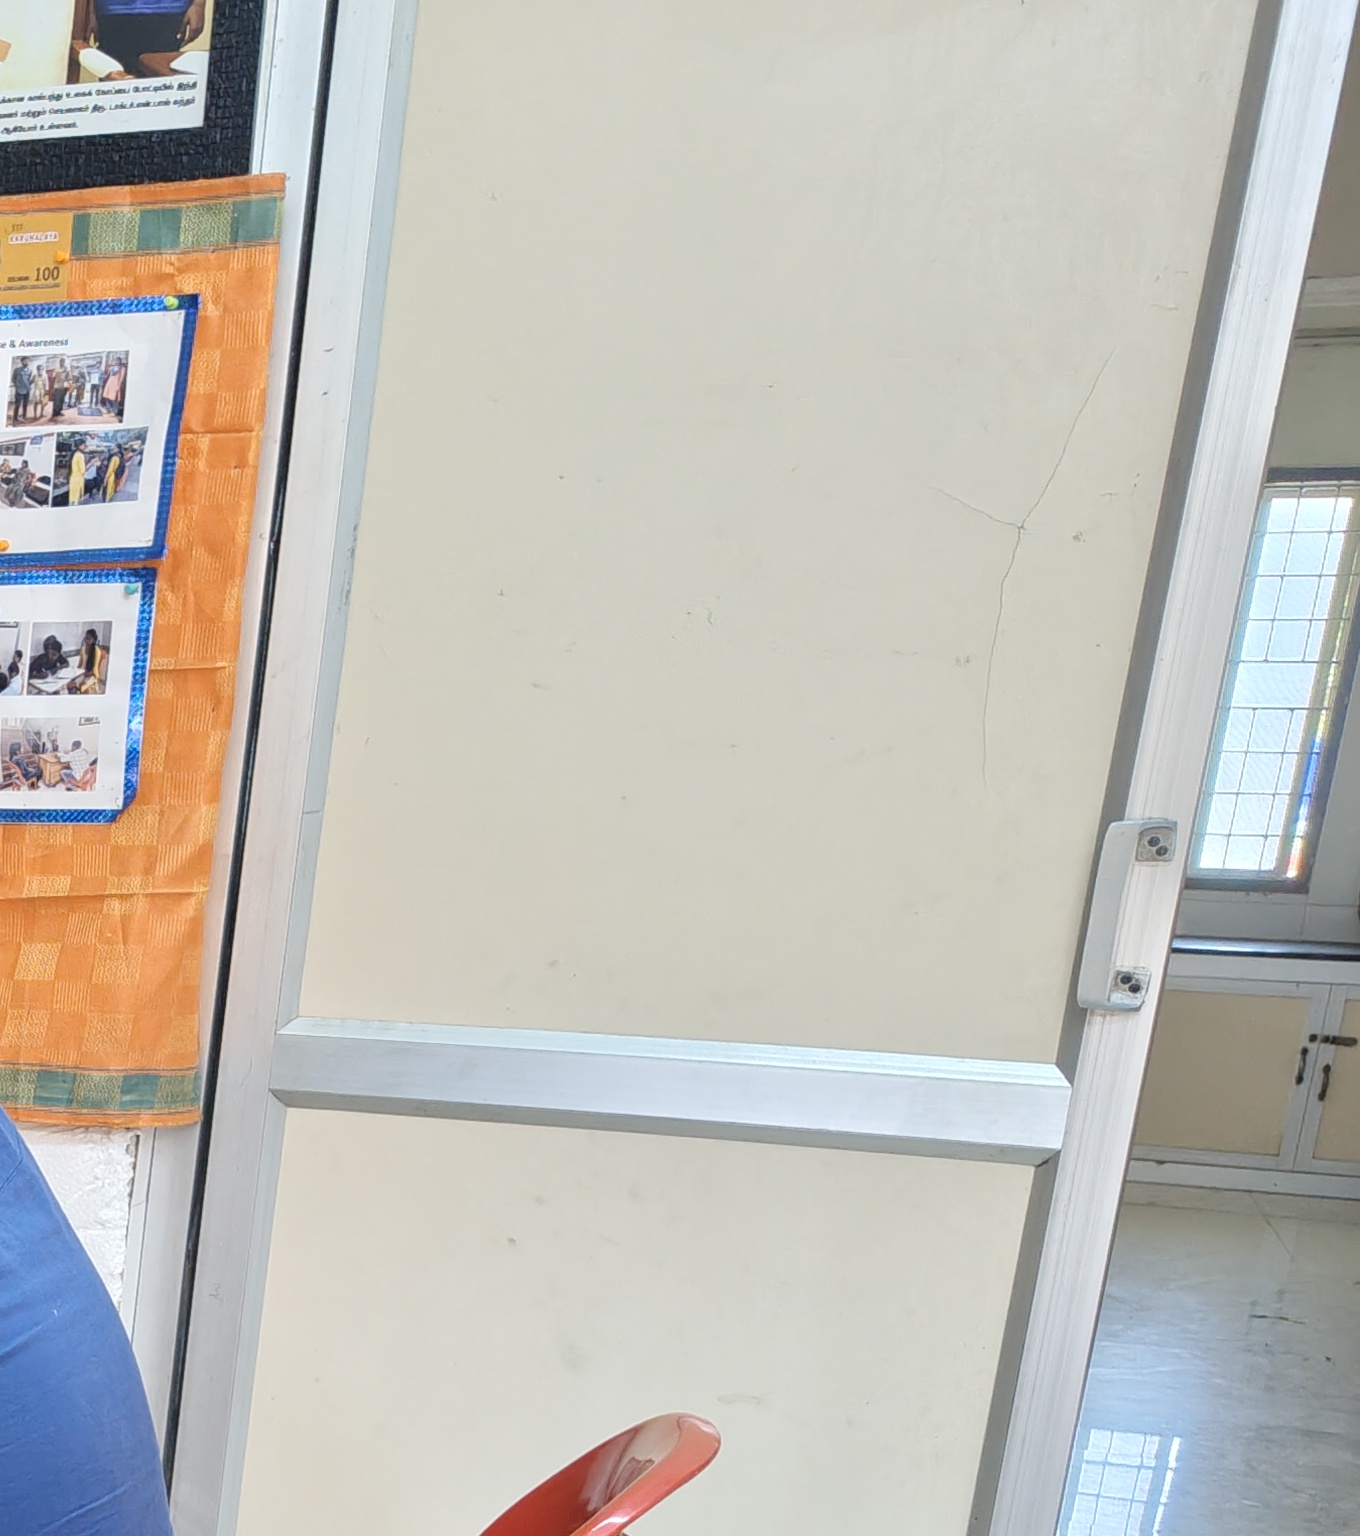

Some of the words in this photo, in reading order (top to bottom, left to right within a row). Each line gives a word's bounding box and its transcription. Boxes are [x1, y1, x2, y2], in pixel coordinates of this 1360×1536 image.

[34, 266, 60, 282] 100
[8, 340, 16, 349] &
[18, 338, 69, 348] Awareness
